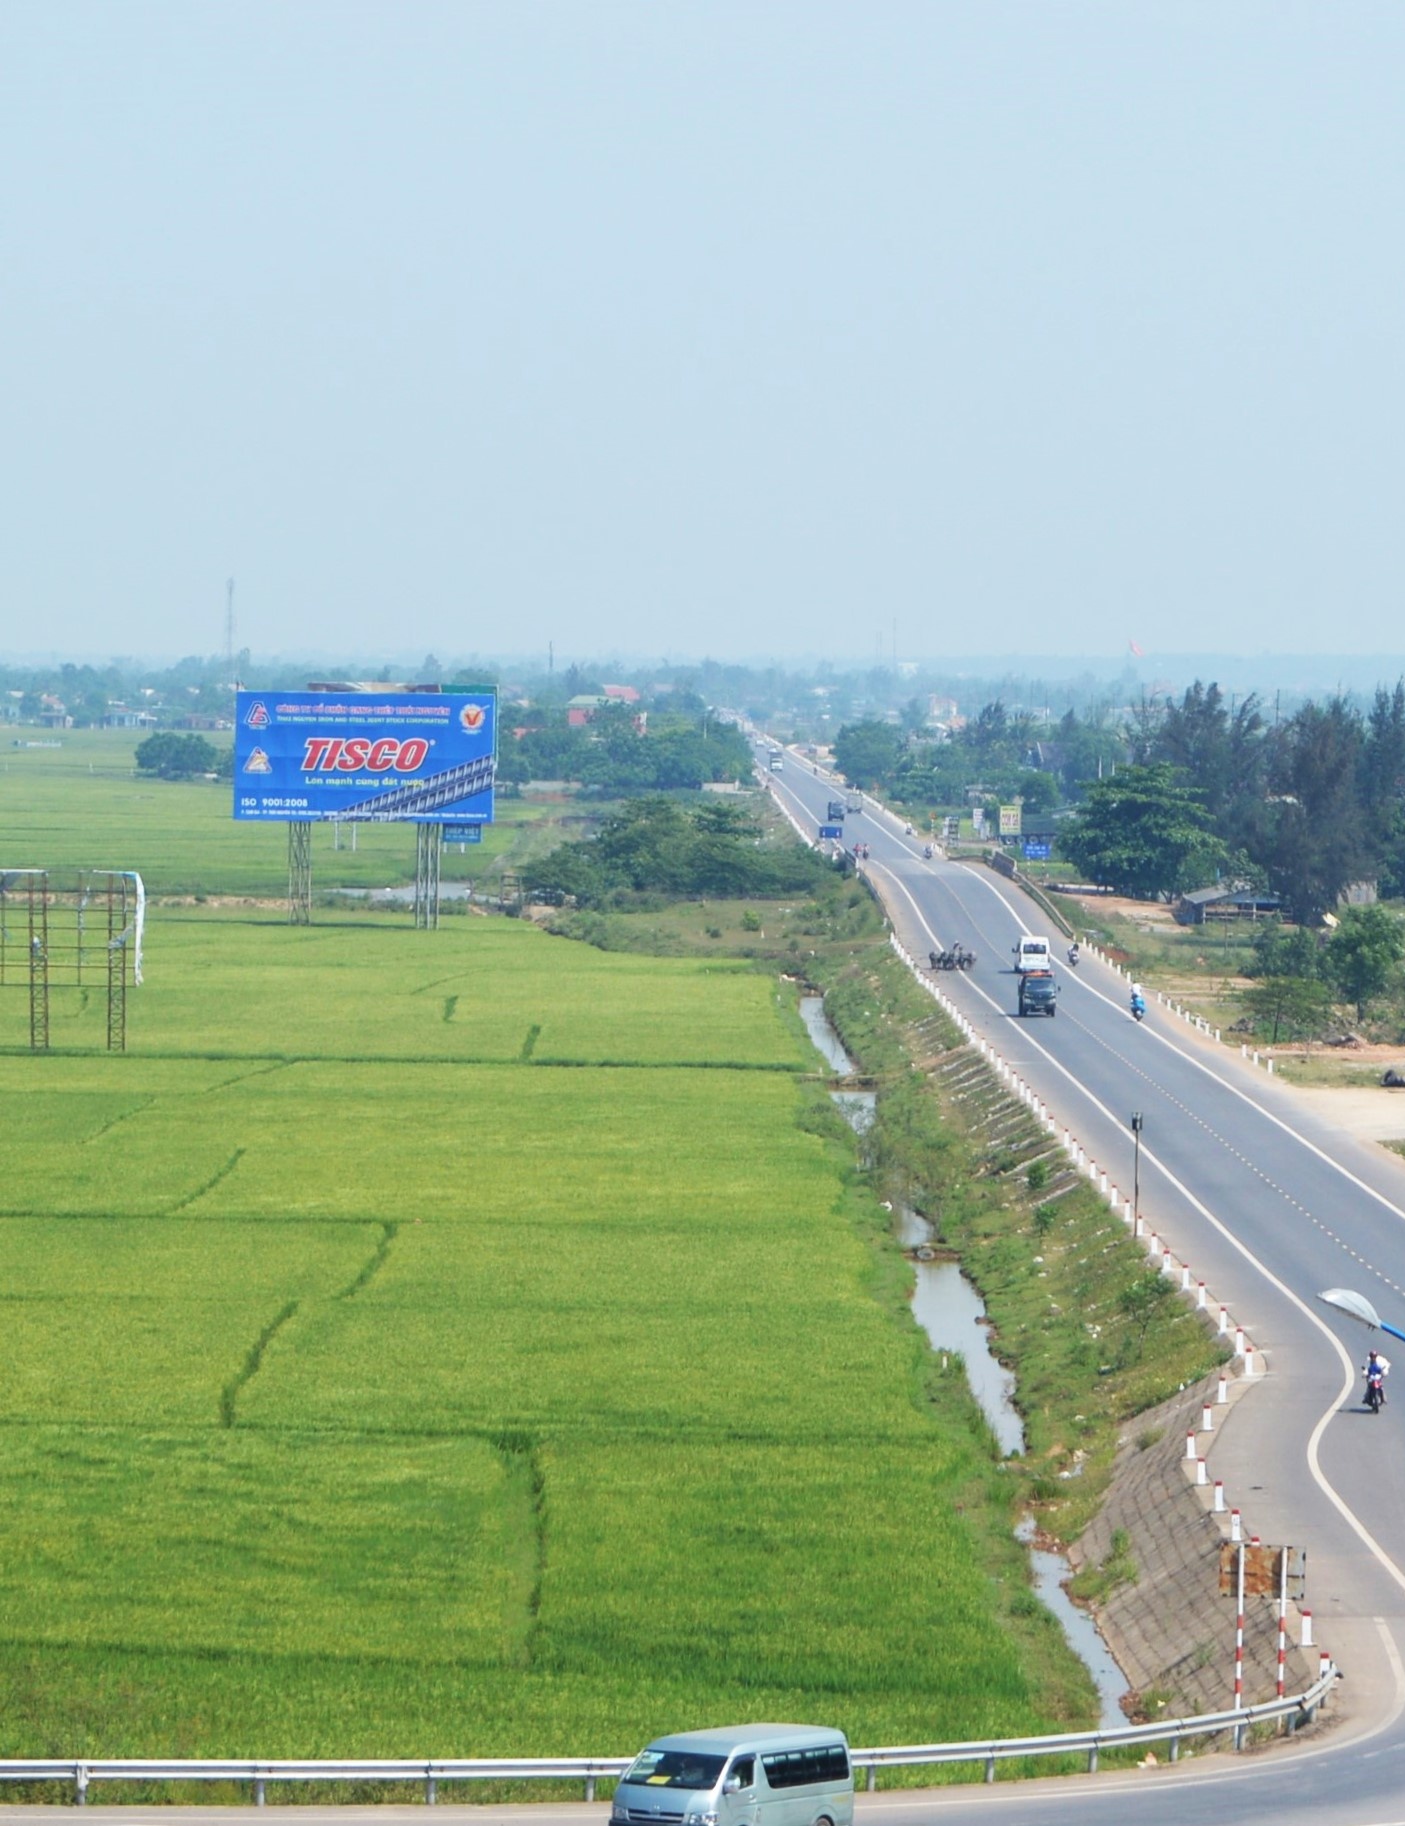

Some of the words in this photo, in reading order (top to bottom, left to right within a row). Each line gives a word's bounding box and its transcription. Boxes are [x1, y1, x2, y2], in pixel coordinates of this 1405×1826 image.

[301, 737, 429, 772] TISCO
[241, 797, 257, 806] ISO
[262, 798, 308, 807] 9001:2008
